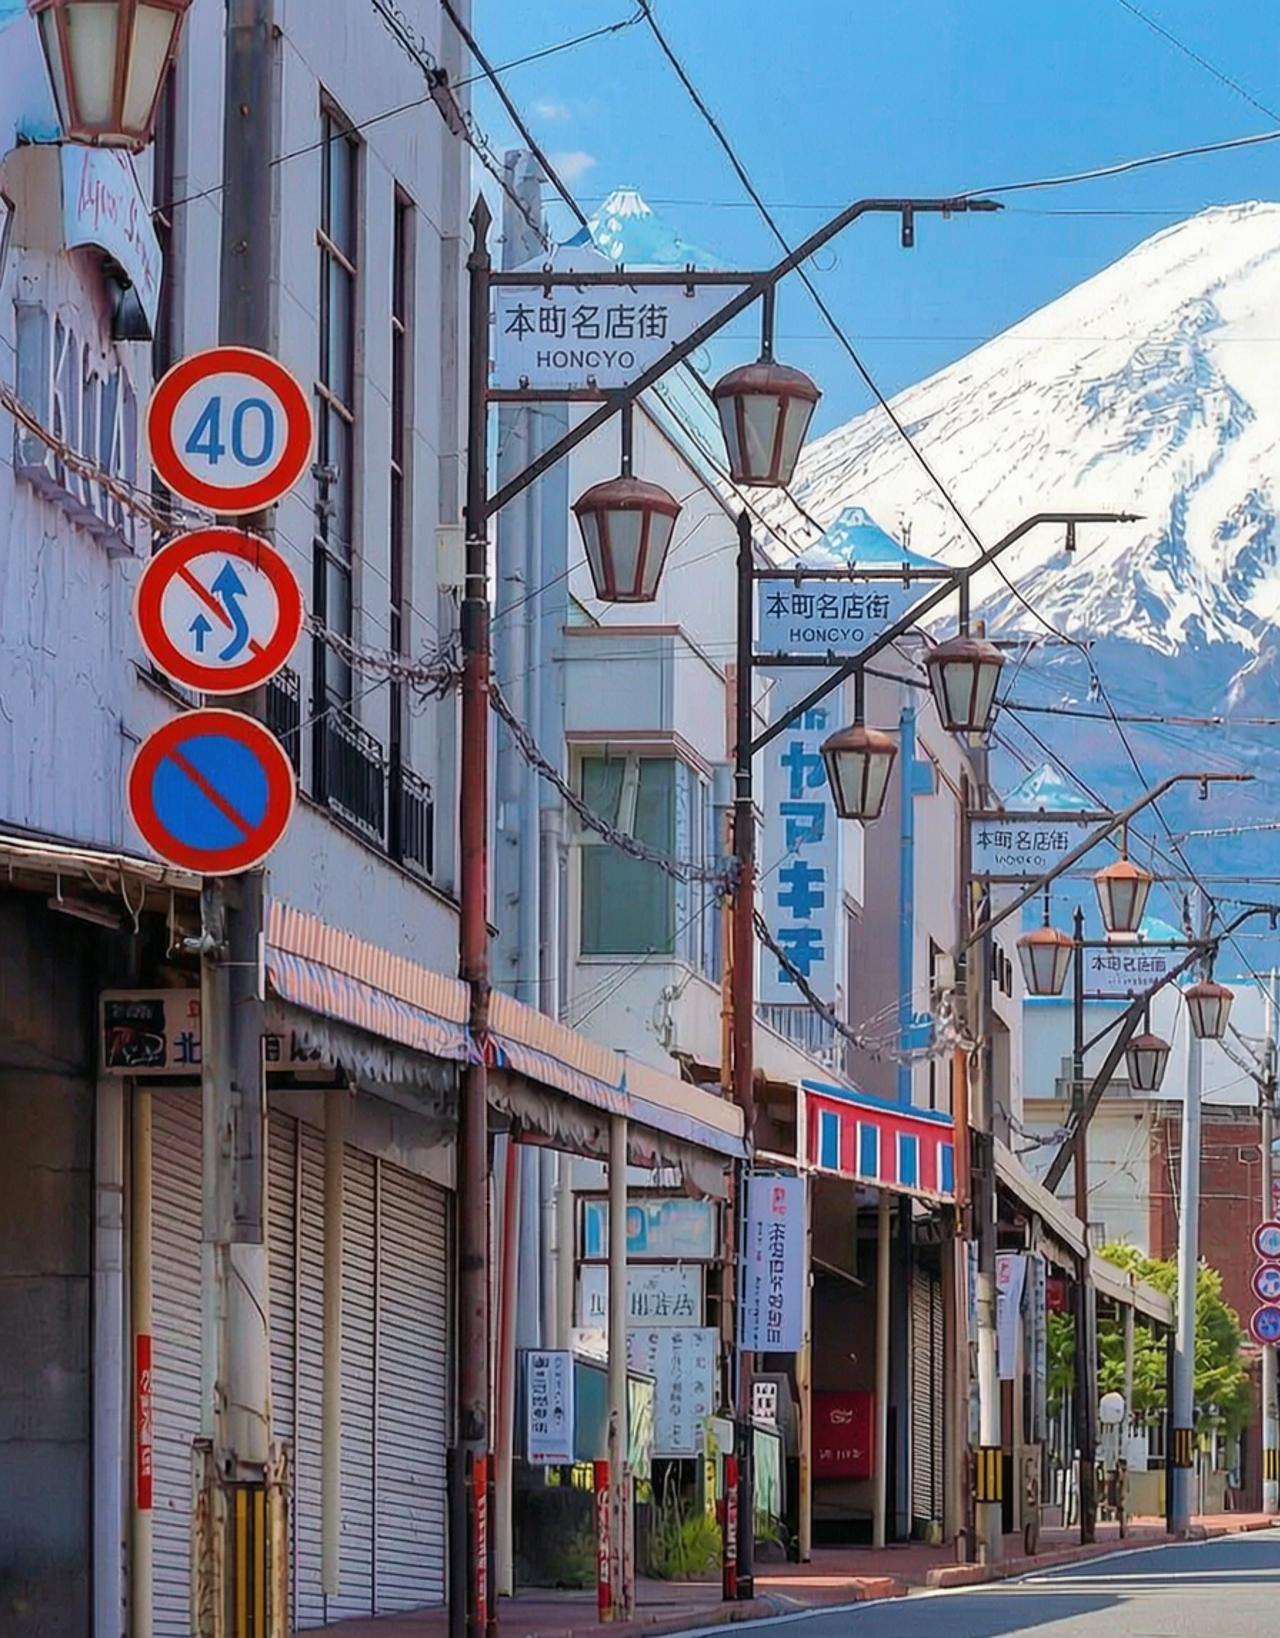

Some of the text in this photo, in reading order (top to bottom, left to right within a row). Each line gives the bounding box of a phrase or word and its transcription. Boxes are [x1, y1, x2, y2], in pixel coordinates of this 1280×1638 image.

[504, 303, 669, 341] 本町名店街
[537, 351, 635, 368] HONCYO
[185, 396, 274, 467] 40
[766, 591, 890, 619] 本町名店街
[790, 628, 864, 642] HONCYO
[977, 827, 1069, 850] 本町名店街
